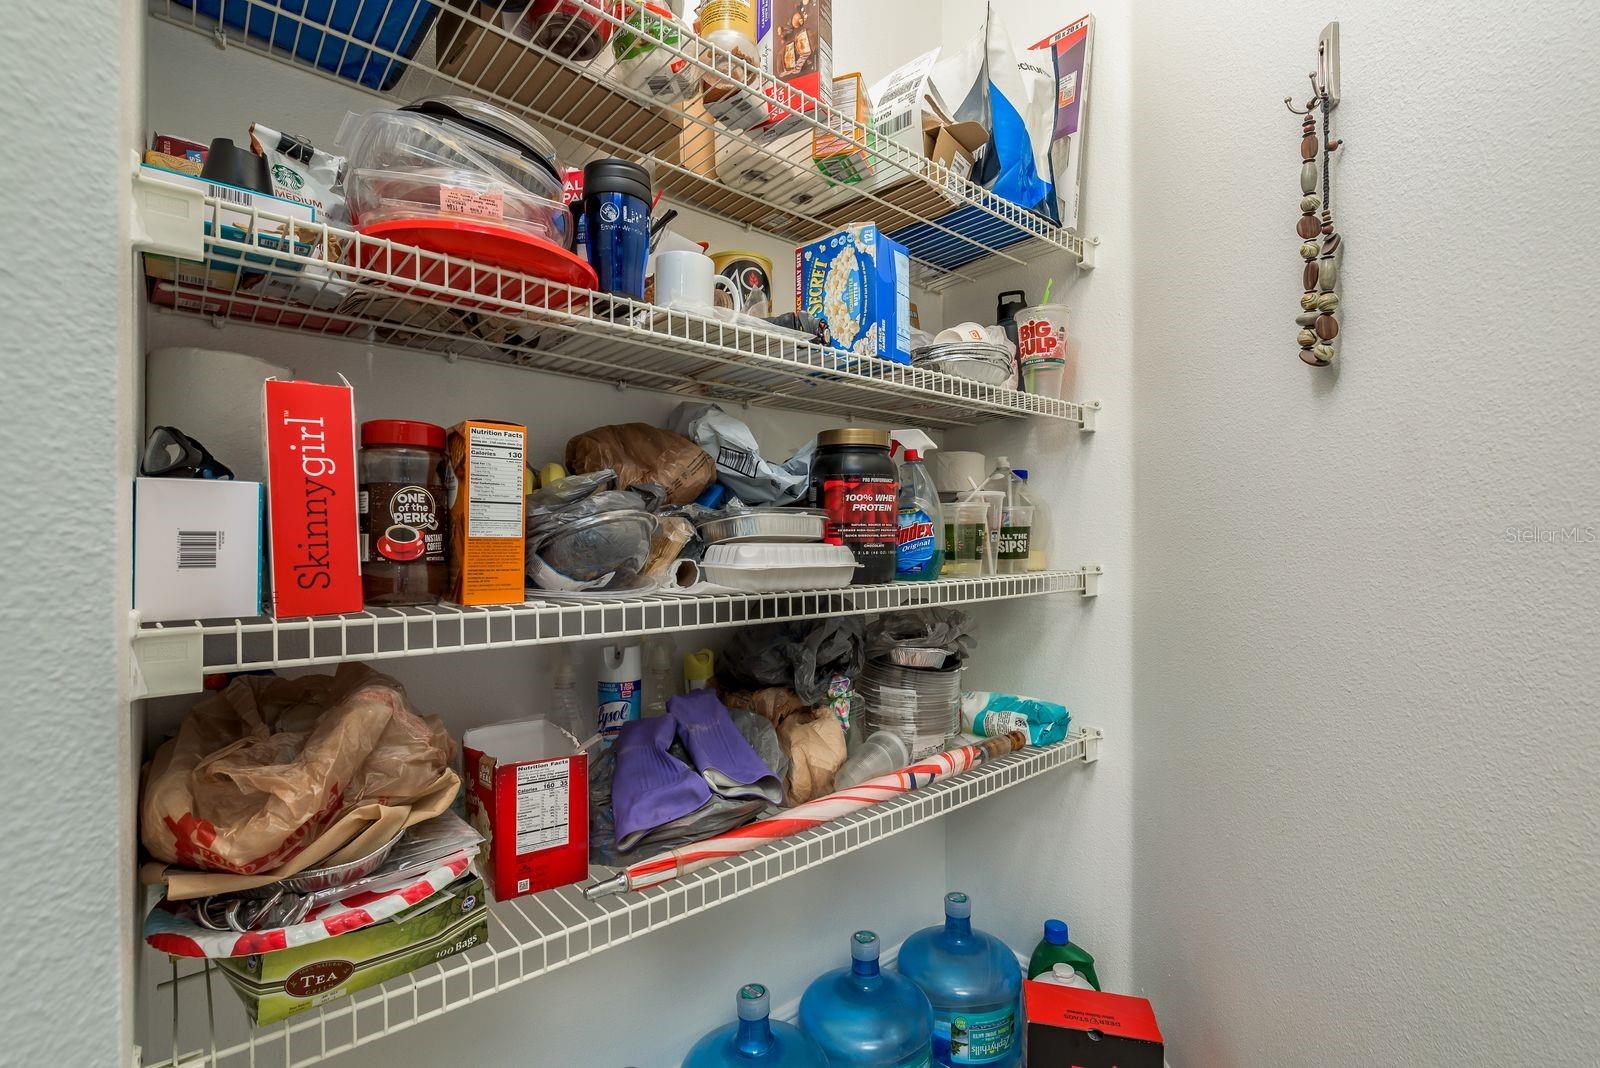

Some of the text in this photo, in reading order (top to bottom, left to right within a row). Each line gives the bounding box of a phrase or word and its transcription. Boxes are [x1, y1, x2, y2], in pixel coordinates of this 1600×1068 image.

[274, 189, 323, 209] MEDIUM
[807, 257, 828, 315] SECRET
[471, 428, 502, 437] Nutrition
[397, 493, 426, 504] ONE
[845, 493, 896, 502] 100% WHEY
[398, 503, 429, 512] of the
[852, 504, 893, 512] PROTEIN
[393, 512, 435, 524] PERKS
[902, 539, 931, 552] Original
[998, 540, 1027, 553] SIPS!
[517, 763, 549, 772] Nutrition
[517, 786, 538, 795] Calories
[436, 934, 478, 959] 100 Bags
[300, 972, 338, 988] TEA
[971, 1035, 1010, 1056] Zephyrhills
